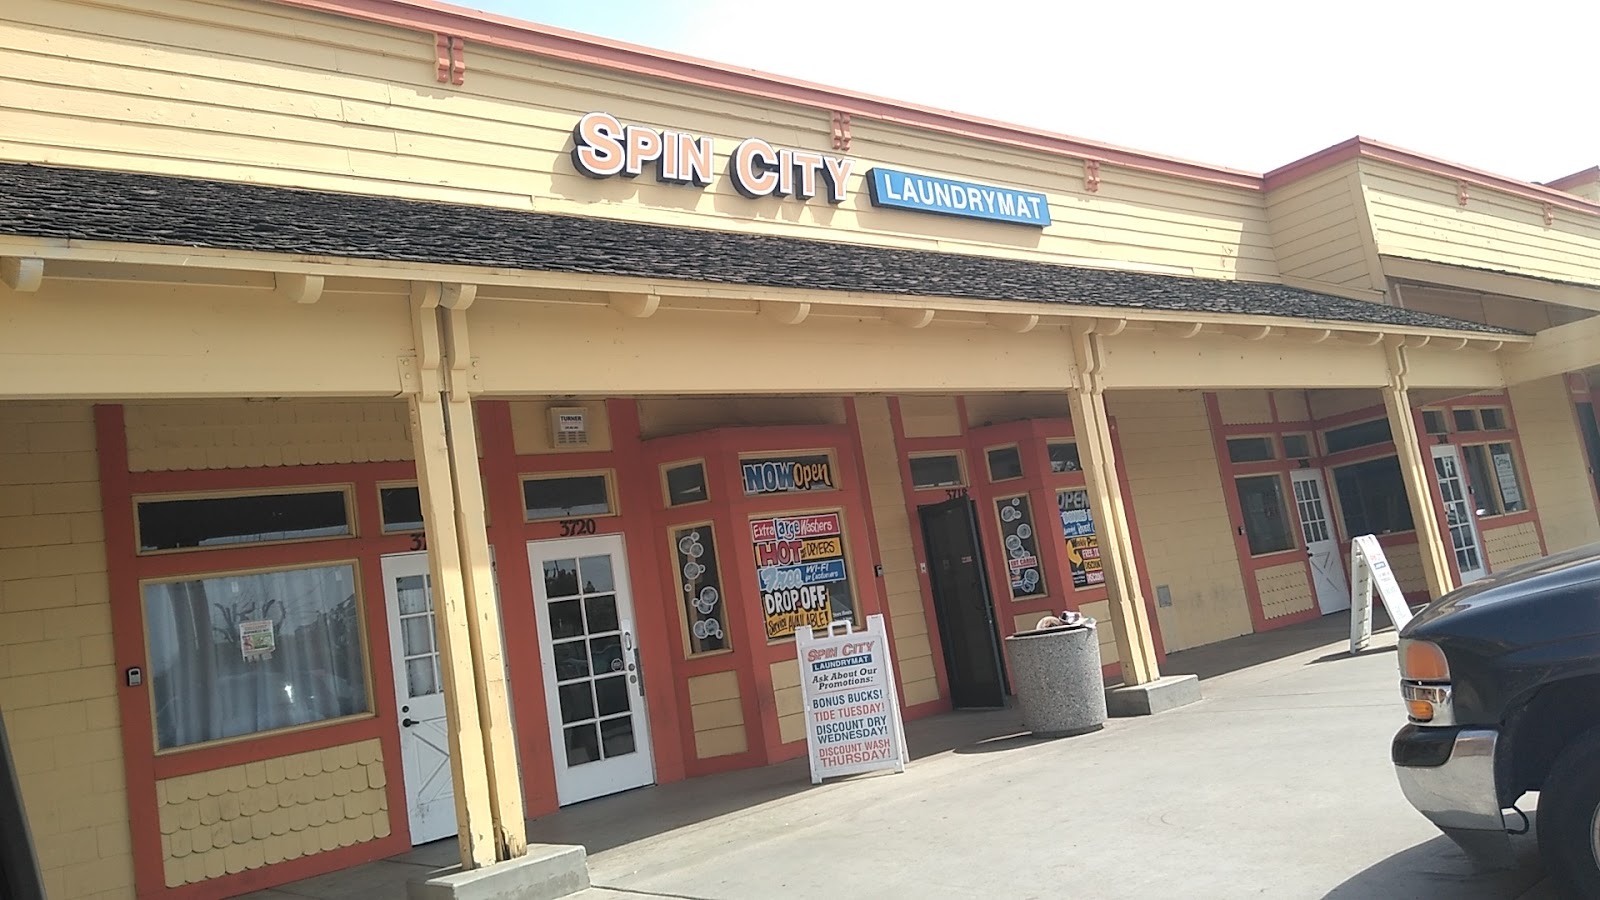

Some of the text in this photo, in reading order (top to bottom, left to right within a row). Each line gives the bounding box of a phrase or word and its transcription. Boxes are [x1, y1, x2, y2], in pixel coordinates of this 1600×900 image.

[571, 111, 856, 203] SPIN CITY
[884, 173, 1041, 220] LAUNDRYMAT
[743, 462, 832, 493] NOW Open
[1056, 490, 1090, 510] OPEN
[559, 519, 596, 537] 3720
[753, 518, 833, 541] Extra Large Washers
[758, 540, 803, 568] HOT
[806, 540, 836, 557] DRYERS
[764, 585, 827, 616] DROP OFF
[768, 616, 790, 636] Service
[807, 640, 875, 662] SPIN CITY
[814, 656, 869, 671] LAUNDRYMAT
[812, 667, 878, 684] Ask About Our
[818, 675, 874, 690] Promotions:
[813, 689, 883, 709] BONUS BUCKS!
[814, 702, 885, 722] TIDE TUESDAY!
[816, 715, 887, 736] DISCOUNT DRY
[817, 725, 888, 745] WEDNESDAY!
[819, 738, 891, 758] DISCOUNT WASH
[820, 747, 891, 768] THURSDAY!
